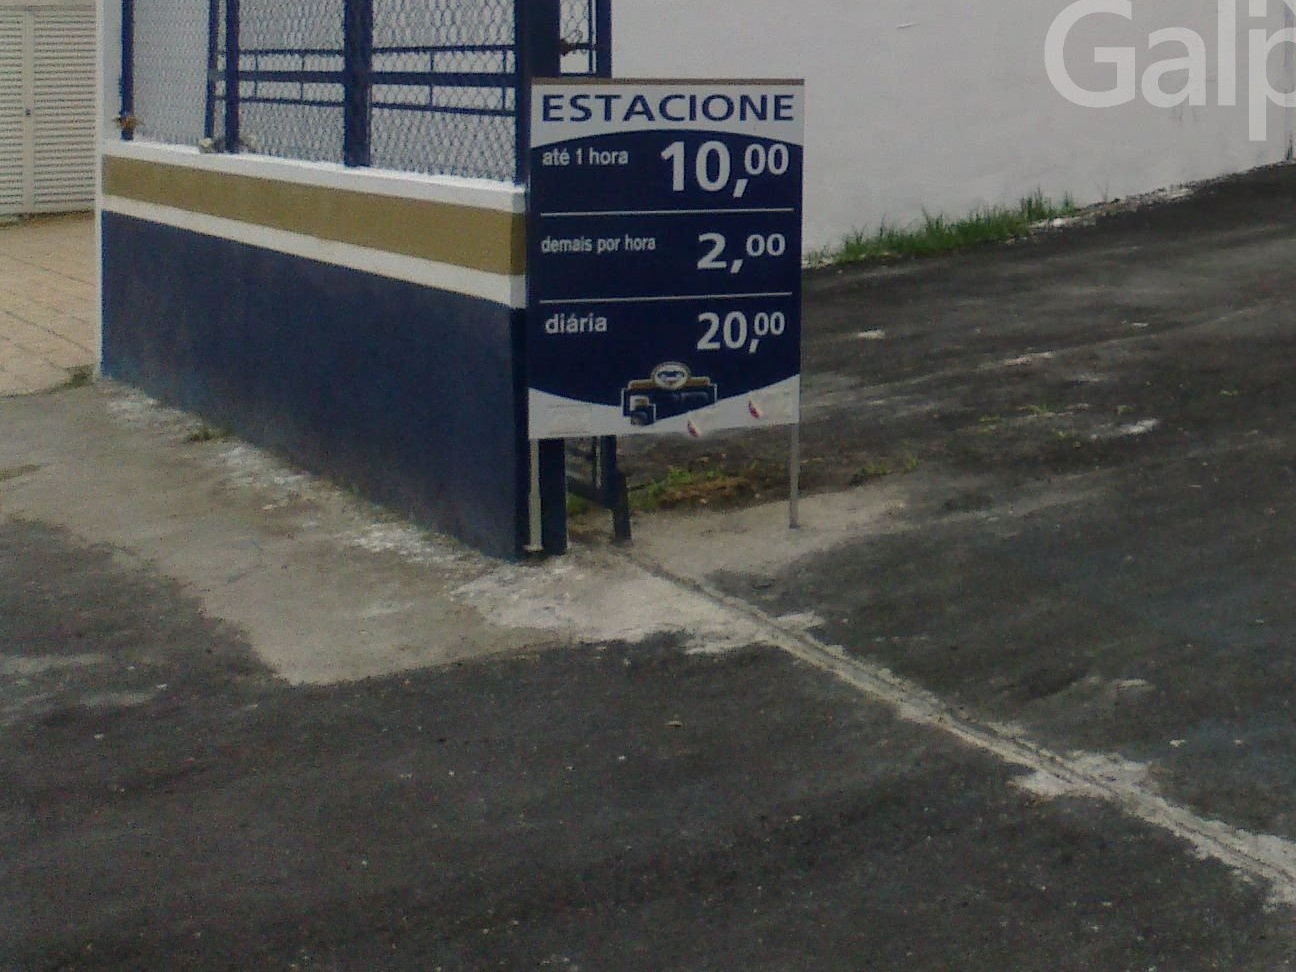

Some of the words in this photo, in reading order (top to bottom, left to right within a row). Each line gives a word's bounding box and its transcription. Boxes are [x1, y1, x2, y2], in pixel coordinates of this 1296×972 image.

[542, 94, 794, 122] ESTACIONE
[543, 148, 570, 166] até
[575, 148, 583, 165] 1
[589, 147, 629, 165] hora
[660, 140, 789, 198] 10,00
[541, 234, 593, 253] demais
[597, 235, 621, 253] por
[625, 234, 656, 251] hora
[697, 233, 786, 274] 2,00
[545, 313, 608, 334] diária
[697, 311, 785, 354] 20,00
